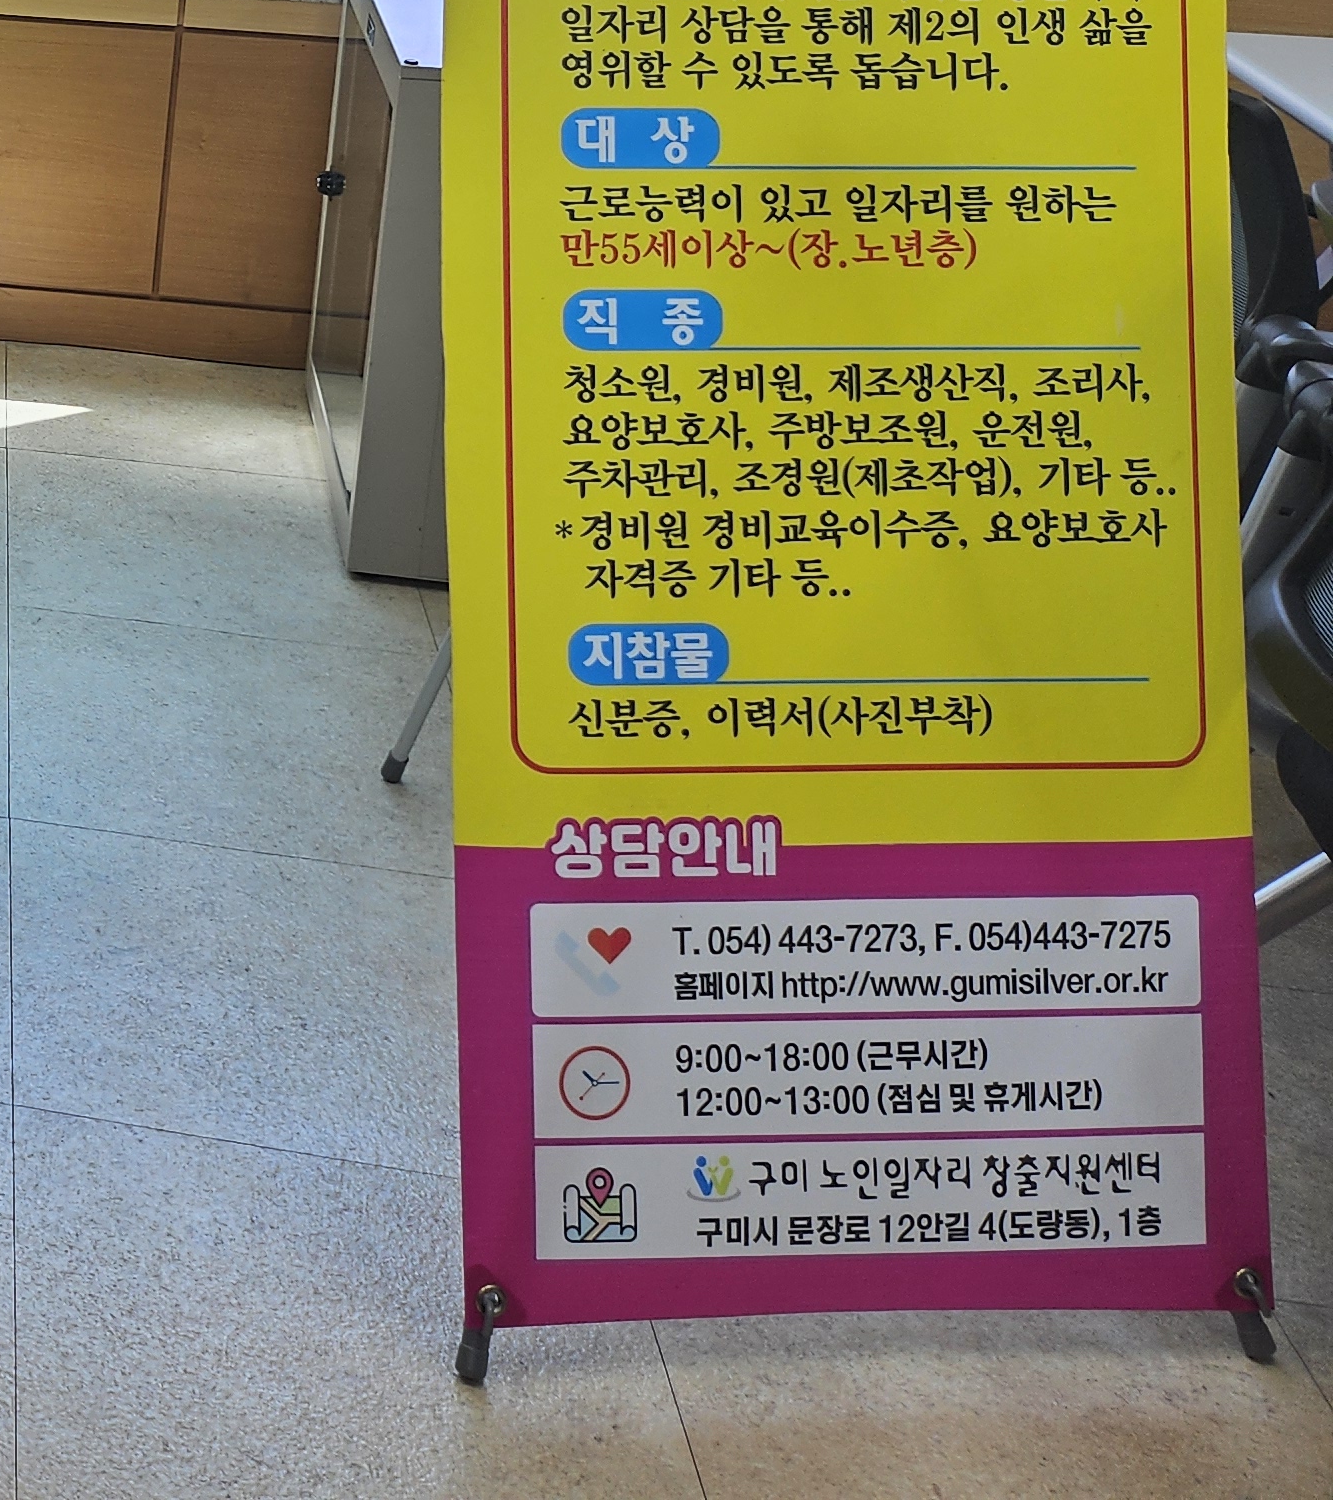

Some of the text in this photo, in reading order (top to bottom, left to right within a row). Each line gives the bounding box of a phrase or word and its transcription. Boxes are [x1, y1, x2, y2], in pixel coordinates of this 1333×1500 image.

[560, 5, 1152, 47] 일자리 상담을 통해 제2의 인생 삶을
[560, 49, 1009, 92] 영위할 수 있도록 돕습니다.
[559, 181, 1117, 225] 근로능력이 있고 일자리를 원하는
[563, 364, 1150, 406] 청소원, 경비원, 제조생산직, 조리사,
[562, 411, 1092, 453] 요양보호사, 주방보조원, 운전원,
[563, 458, 1177, 500] 주차관리, 조경원(제초작업), 기타 등..
[702, 510, 966, 549] 경비교육이수증,
[983, 510, 1167, 549] 요양보호사
[584, 558, 851, 599] 자격증 기타 등..
[582, 632, 712, 680] 지참물
[568, 695, 994, 739] 신분증, 이력서(사진부착)
[551, 820, 780, 878] 상담안내
[673, 927, 700, 955] T.
[708, 925, 772, 955] 054)
[778, 923, 926, 955] 443-7273,
[934, 923, 961, 953] F.
[673, 969, 1169, 1004] 홈페이지 http://www.gumisilver.or.kr
[675, 1038, 988, 1072] 9:00~18:00 (근무시간)
[677, 1079, 1102, 1116] 12:00~13:00 (점심 및 휴게시간)
[748, 1152, 1161, 1200] 구미 노인일자리 창출지원센터
[697, 1208, 1161, 1247] 구미시 문장로 12안길 4(도량동), 1층
